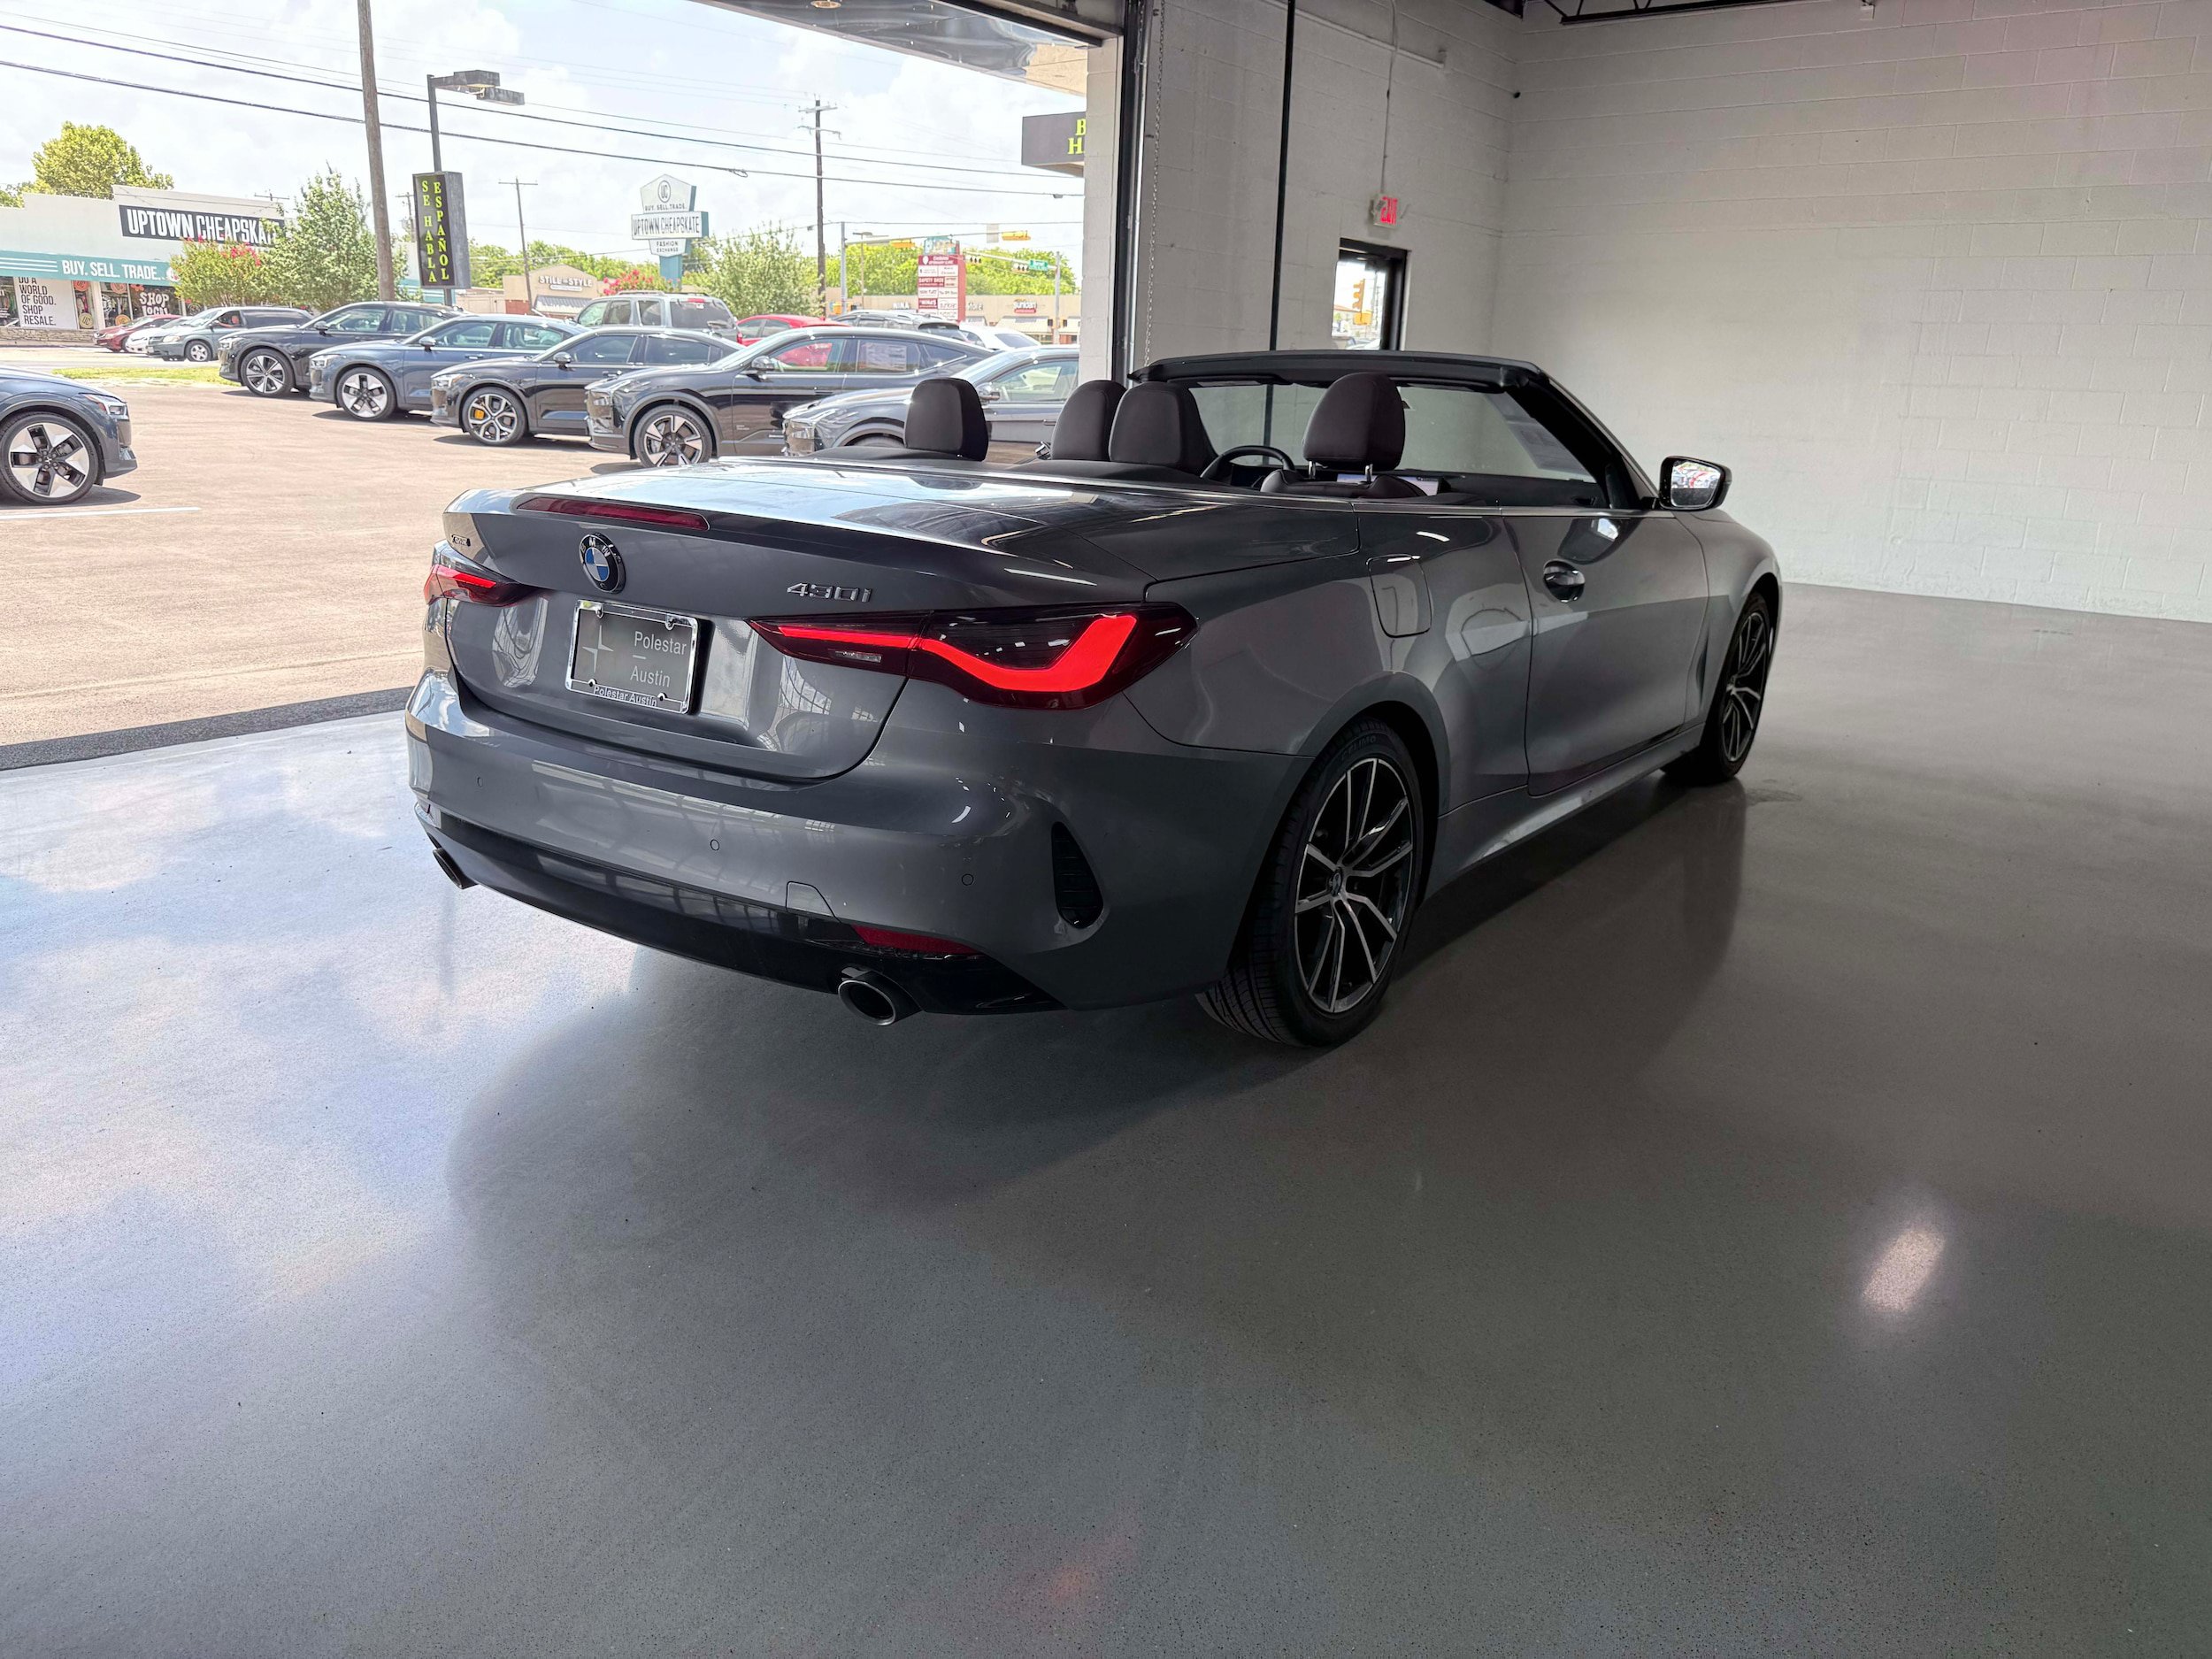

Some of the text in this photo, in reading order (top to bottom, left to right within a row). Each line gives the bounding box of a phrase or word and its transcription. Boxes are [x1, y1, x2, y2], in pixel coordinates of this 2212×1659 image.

[421, 180, 431, 206] SE
[127, 208, 195, 239] UPTOWN
[434, 181, 449, 280] ESPAÑOL
[633, 216, 700, 236] UPTOWN CHEAPSKATE
[424, 215, 437, 282] HABLA
[62, 259, 88, 276] BUY.
[19, 284, 48, 296] WORLD
[539, 275, 562, 285] STILL
[568, 277, 593, 288] STYLE
[20, 294, 57, 305] OF GOOD.
[22, 304, 43, 315] SHOP
[140, 292, 170, 307] SHOP
[24, 314, 57, 326] RESALE.
[580, 535, 611, 557] BMW
[787, 582, 872, 603] 430i
[634, 631, 687, 656] Polestar
[630, 665, 671, 688] Austin
[593, 686, 658, 707] Polestar Austin
